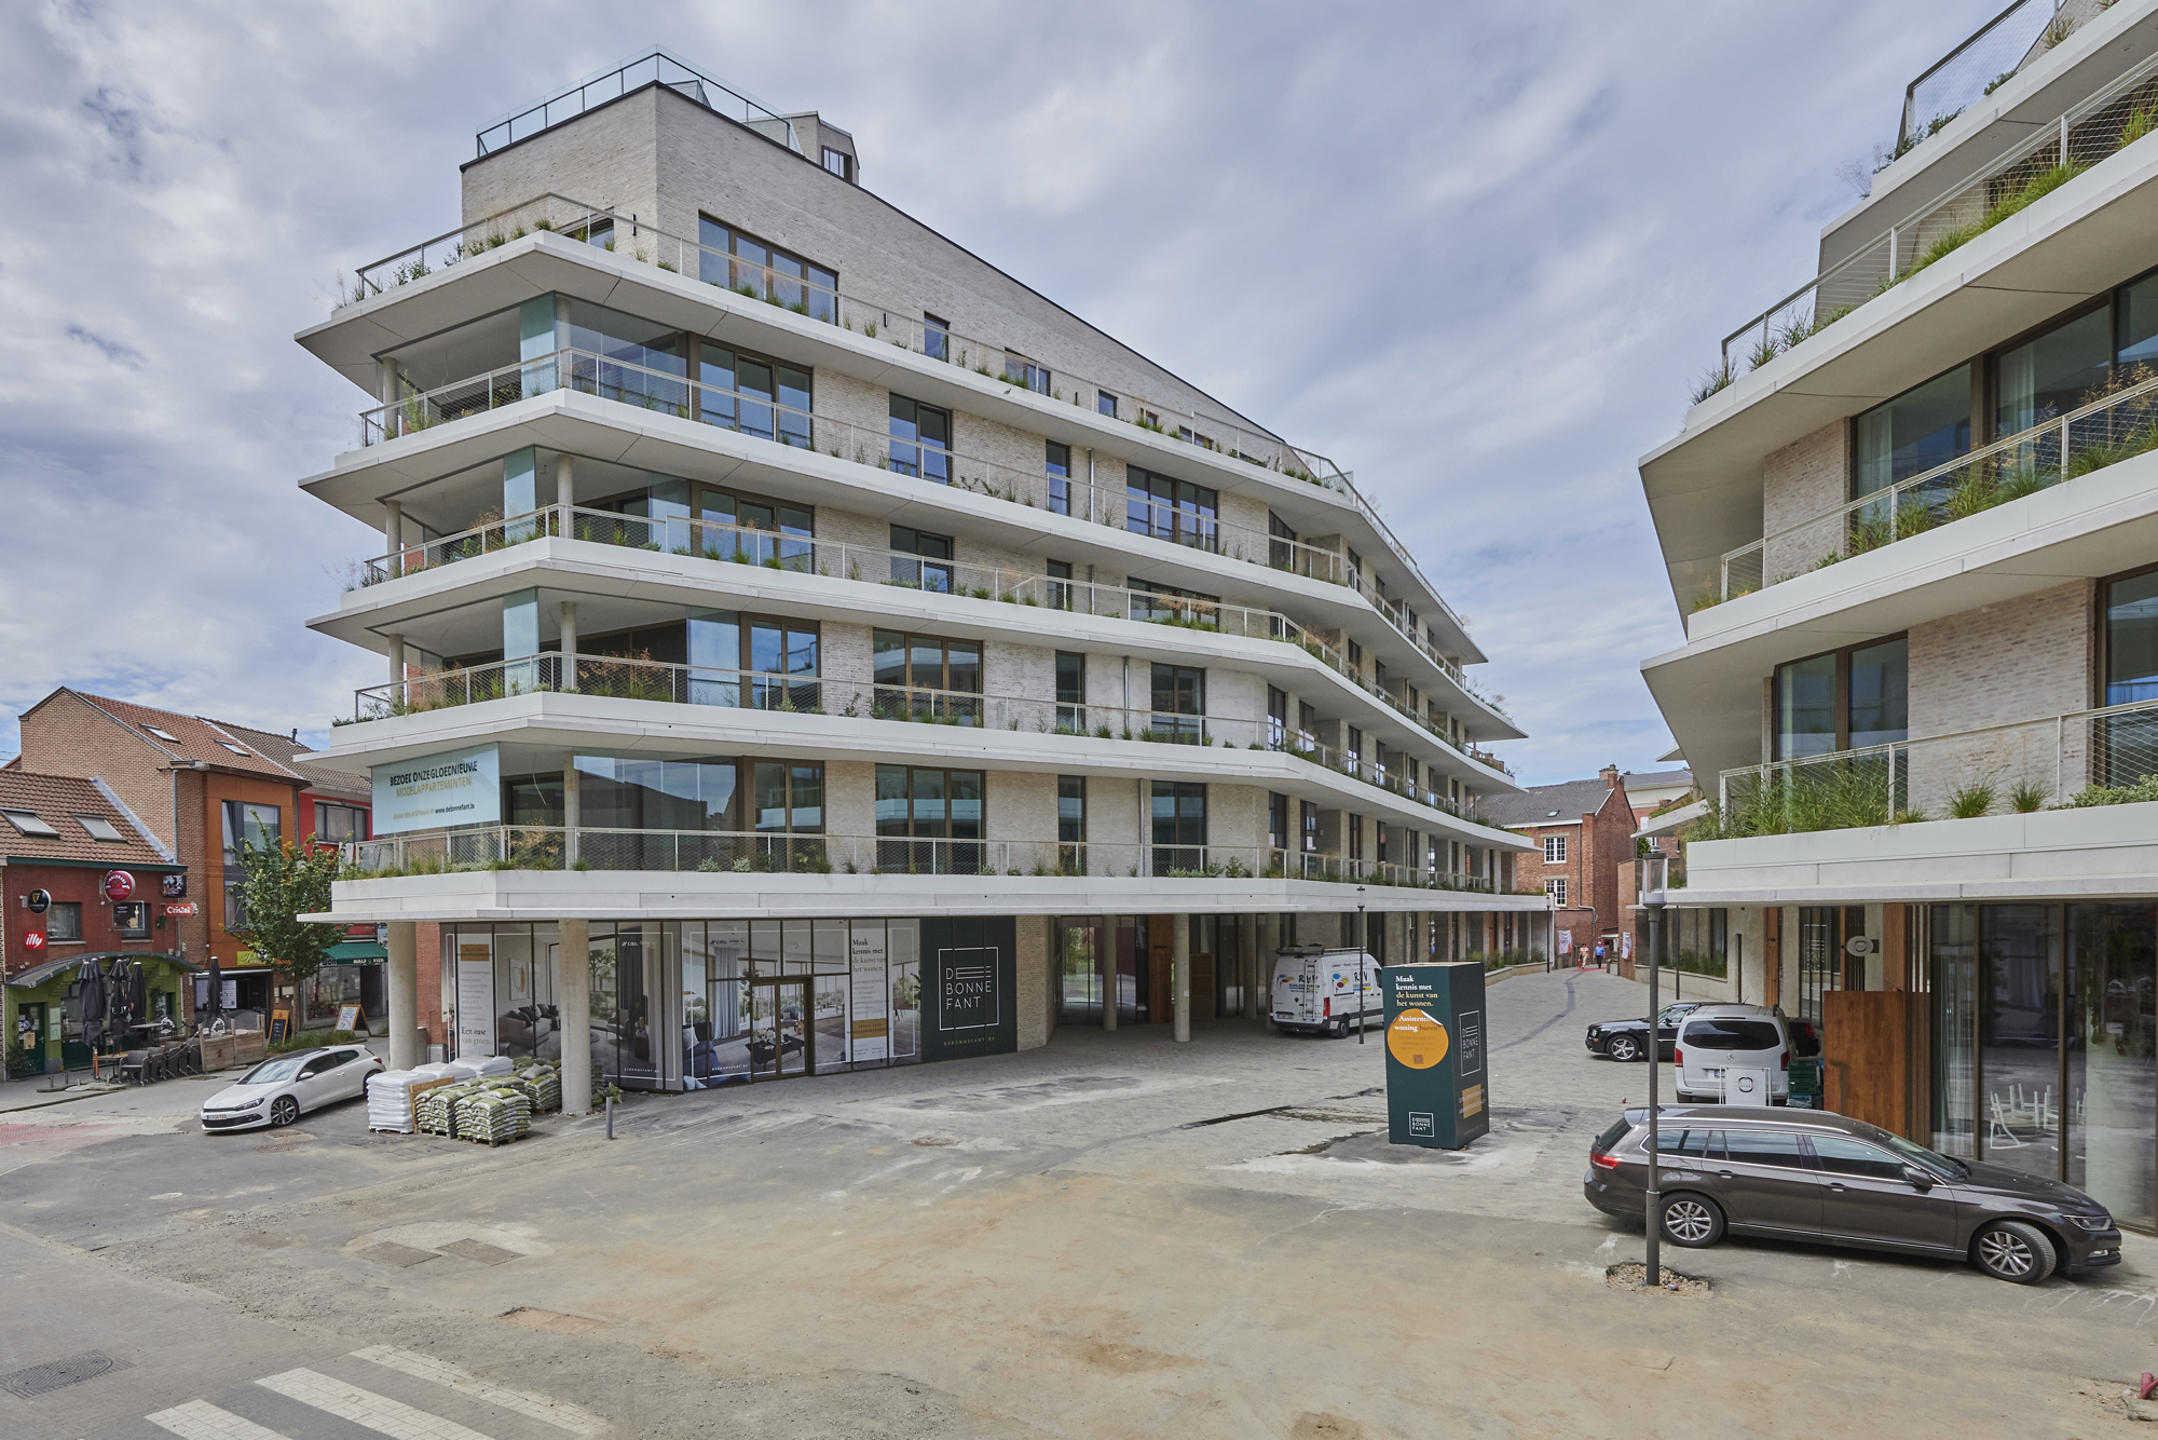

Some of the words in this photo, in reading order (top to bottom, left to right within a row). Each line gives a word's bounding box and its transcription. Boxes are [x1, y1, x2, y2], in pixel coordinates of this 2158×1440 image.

[413, 769, 430, 782] ONZE
[26, 933, 43, 949] illy
[945, 981, 992, 995] BONNE
[1395, 983, 1417, 991] kennis
[945, 996, 981, 1010] FANT
